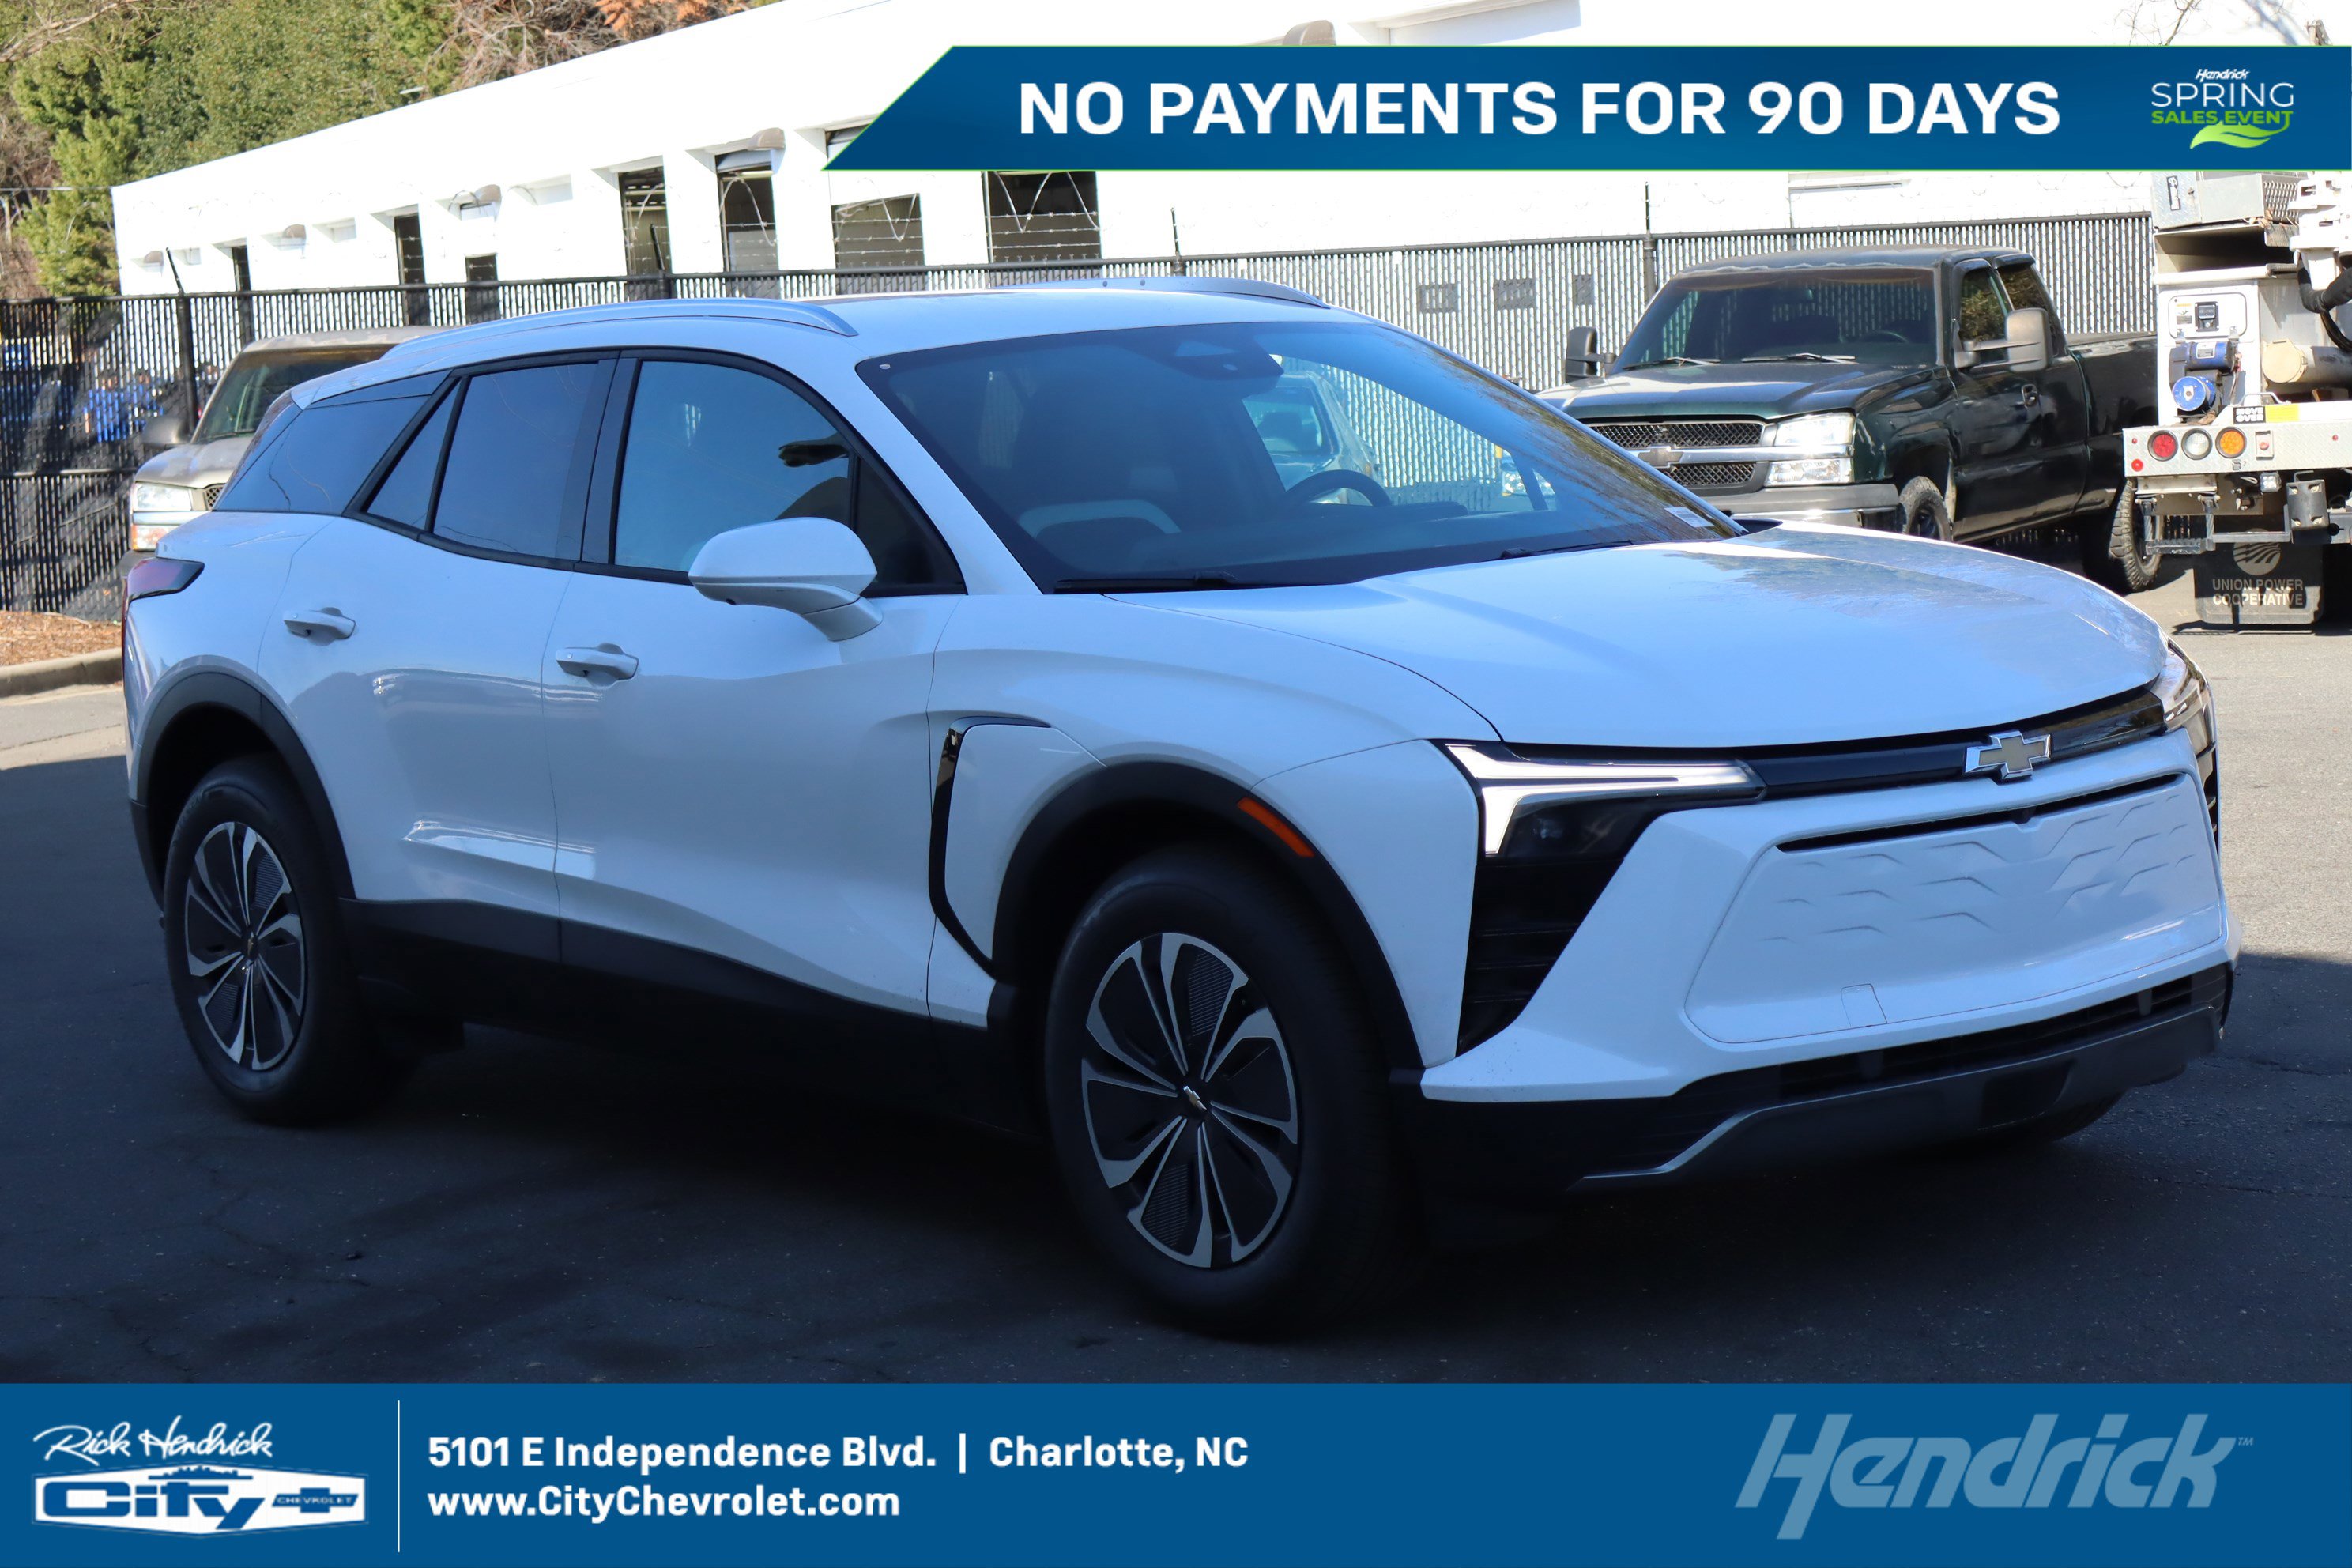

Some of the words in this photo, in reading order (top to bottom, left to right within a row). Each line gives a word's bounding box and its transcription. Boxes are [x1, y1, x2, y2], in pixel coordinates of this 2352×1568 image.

[2213, 579, 2252, 590] UNION
[2256, 579, 2303, 590] POWER
[2213, 593, 2303, 605] COOPERATIVE
